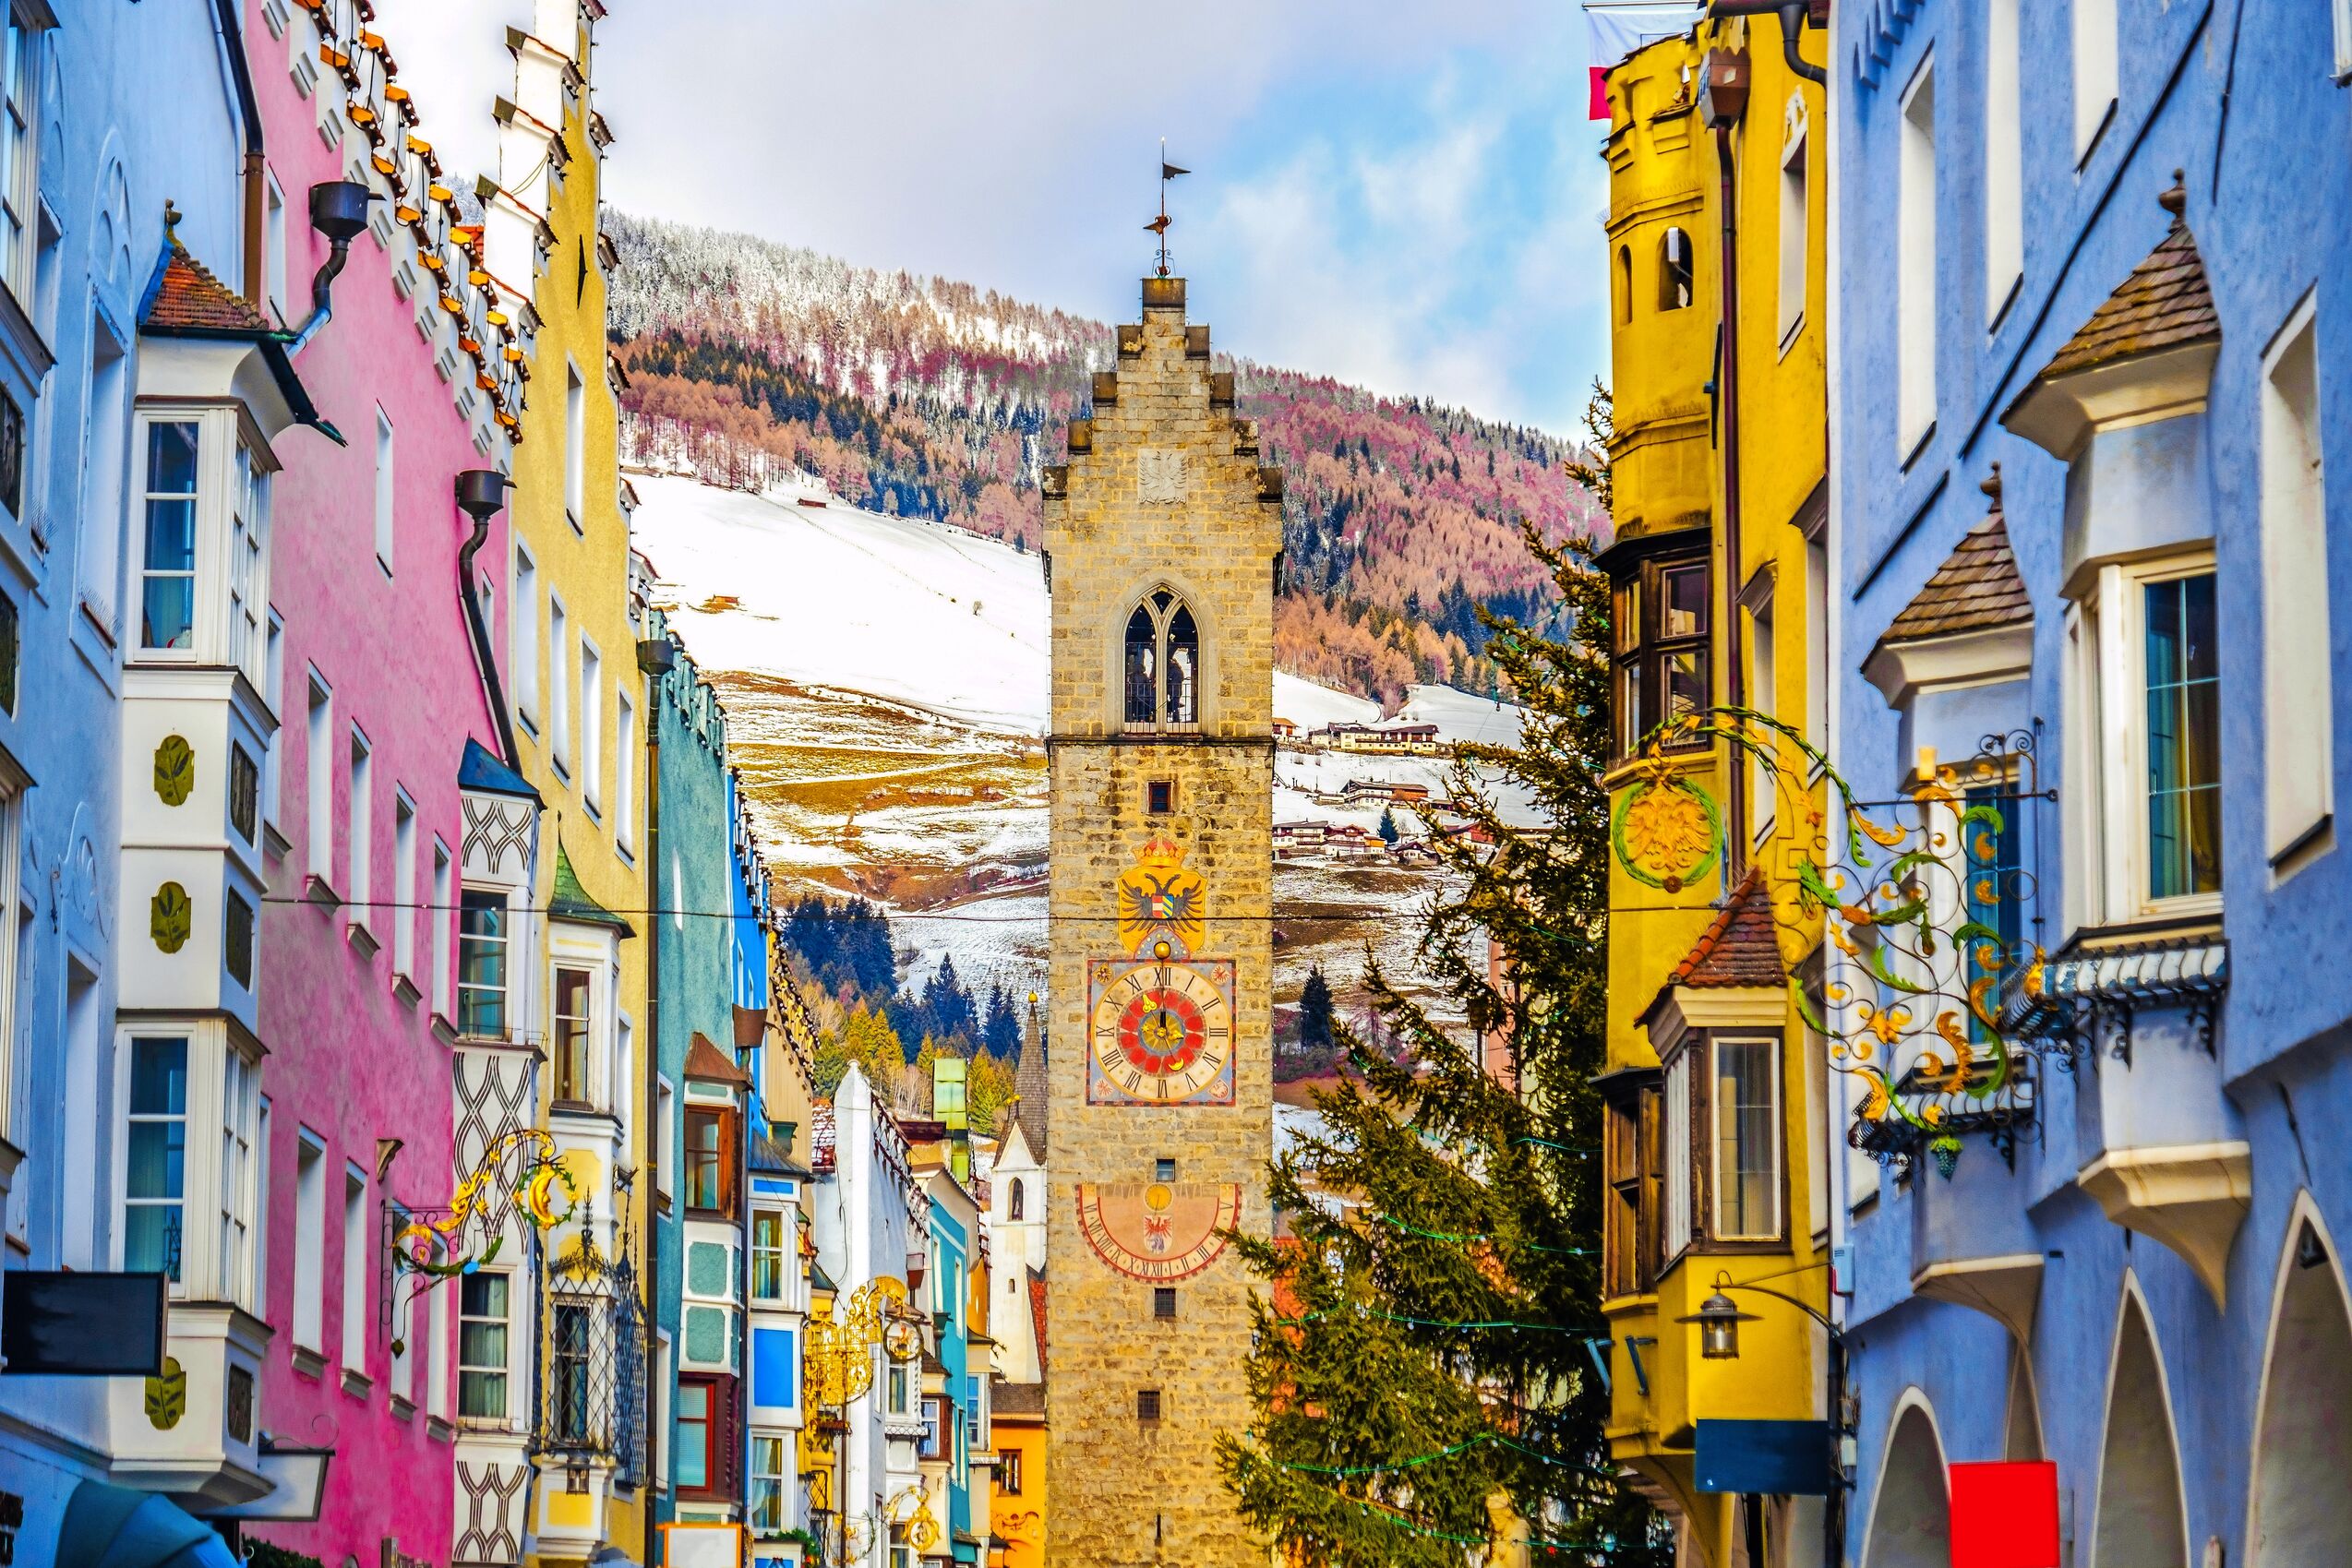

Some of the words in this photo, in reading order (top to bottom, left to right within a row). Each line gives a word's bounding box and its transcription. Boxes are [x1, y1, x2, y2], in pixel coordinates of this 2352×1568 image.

[1123, 974, 1143, 995] XI
[1154, 967, 1171, 987] XII
[1184, 975, 1195, 992] I
[1104, 994, 1123, 1012] X
[1202, 997, 1221, 1011] II
[1096, 1025, 1115, 1037] IX
[1209, 1026, 1229, 1038] III
[1101, 1048, 1124, 1072] VIII
[1202, 1051, 1221, 1071] IV
[1123, 1071, 1142, 1093] VII
[1158, 1079, 1169, 1098] VI
[1185, 1072, 1199, 1092] V
[1084, 1203, 1098, 1214] VI
[1219, 1202, 1234, 1210] V
[1087, 1218, 1103, 1236] VII
[1096, 1233, 1114, 1253] VIII
[1110, 1248, 1124, 1263] IX
[1196, 1245, 1211, 1261] III
[1127, 1257, 1138, 1273] X
[1140, 1261, 1150, 1275] XI
[1150, 1263, 1163, 1277] XII
[1181, 1257, 1190, 1272] II
